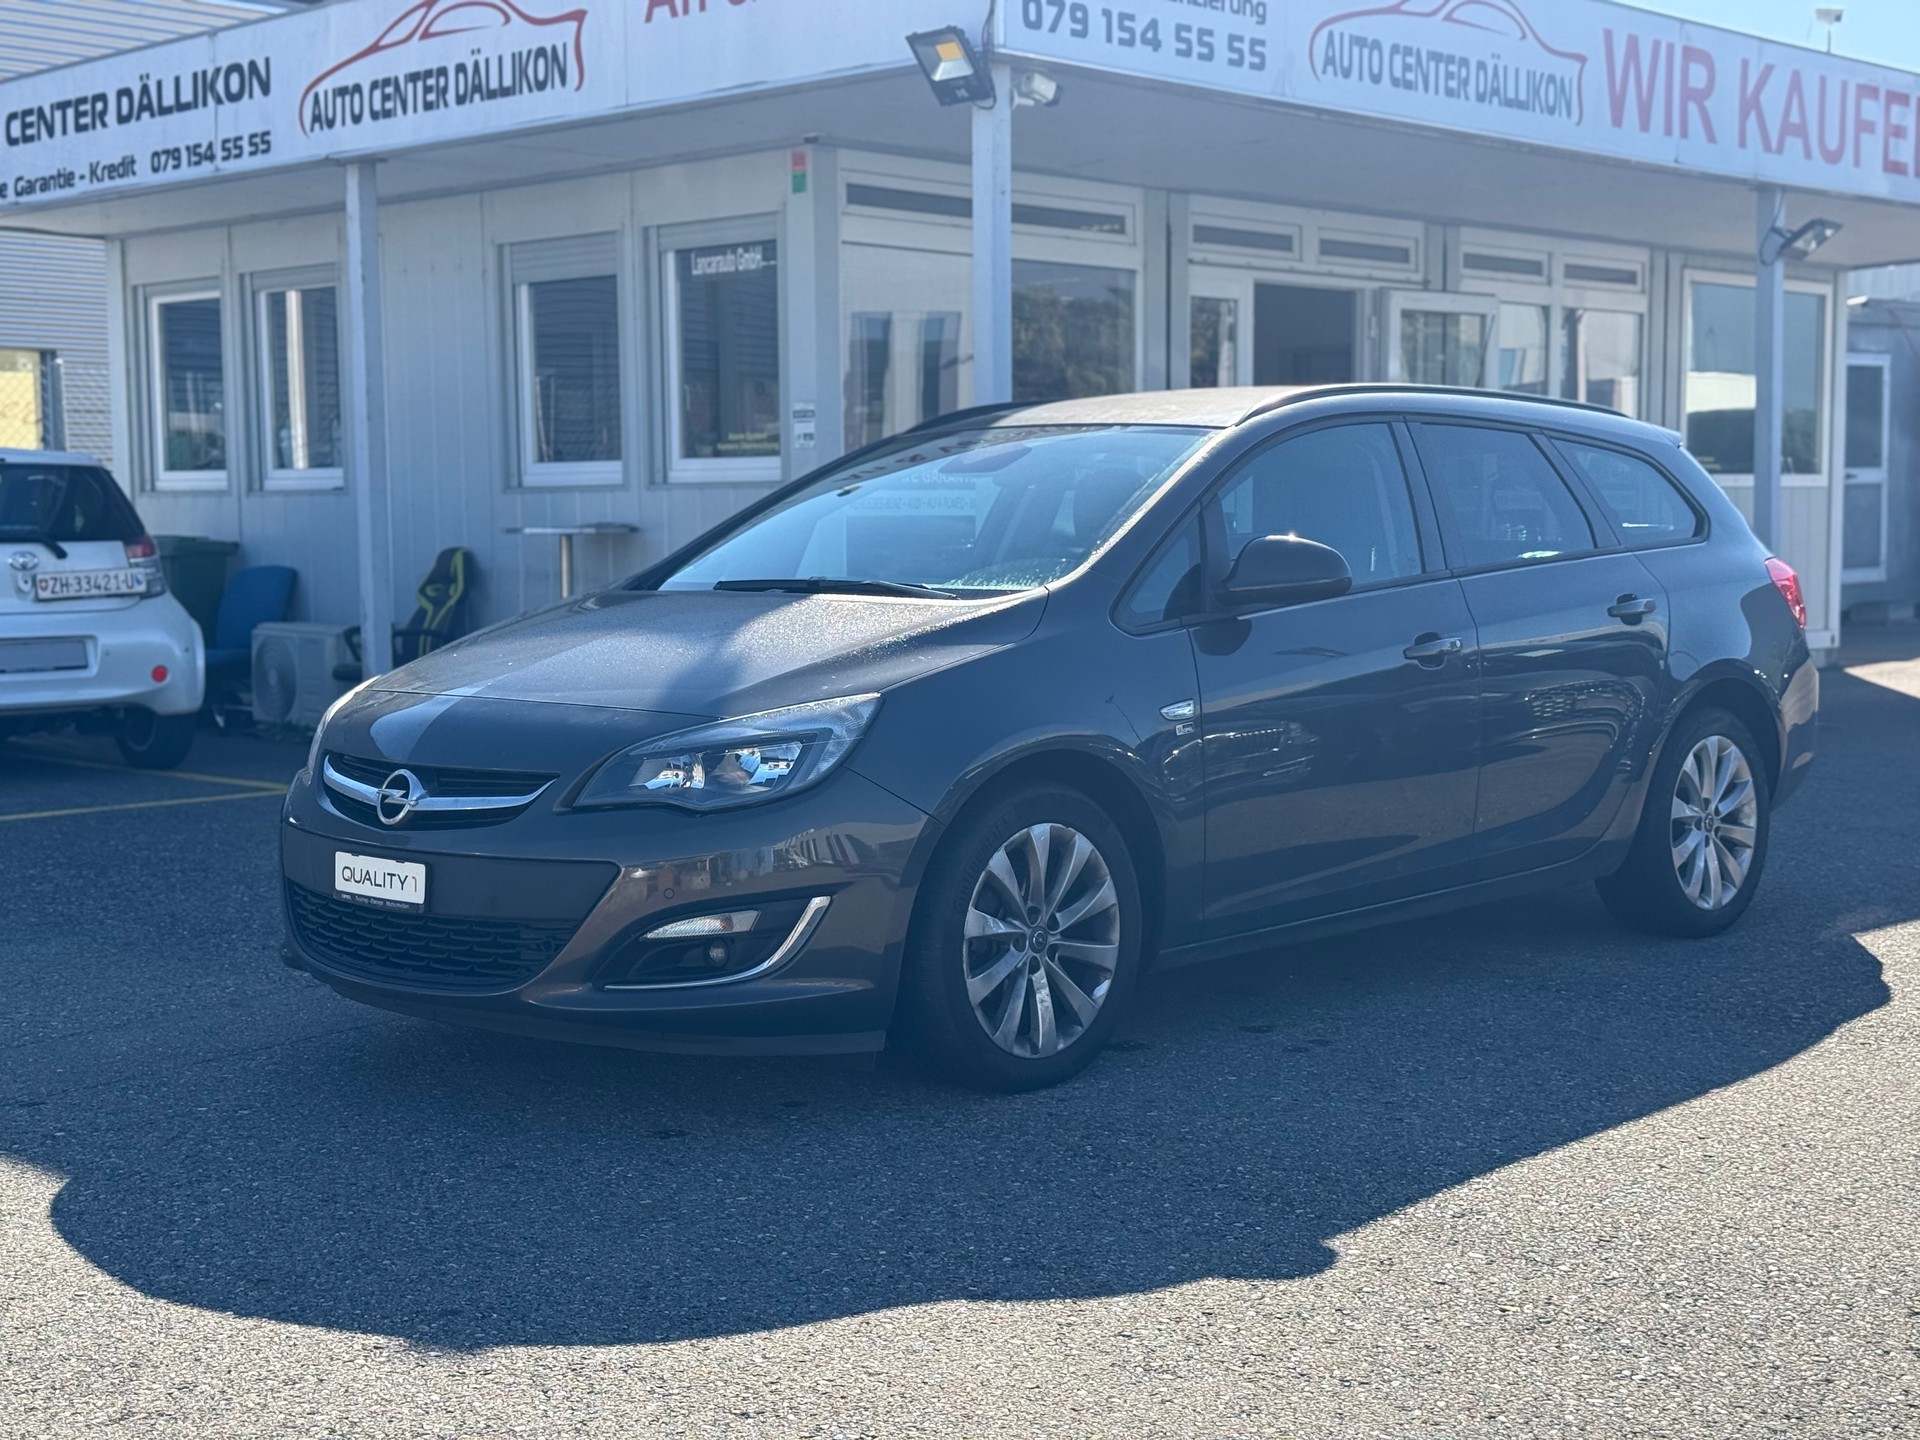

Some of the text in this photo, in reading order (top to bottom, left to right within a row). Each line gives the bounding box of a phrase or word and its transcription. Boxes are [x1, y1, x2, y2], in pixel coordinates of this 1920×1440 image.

[1021, 0, 1266, 71] 079 154 55 55
[1321, 29, 1573, 119] AUTO CENTER DÄLLIKON
[5, 56, 272, 147] CENTER DÄLLIKON
[309, 42, 567, 133] AUTO CENTER DÄLLIKON
[1603, 27, 1718, 145] WIR
[14, 168, 76, 198] Garantie
[89, 154, 137, 184] Kredit
[150, 149, 182, 174] 079
[186, 140, 215, 168] 154
[221, 135, 243, 162] 55
[248, 130, 272, 155] 55
[341, 865, 418, 893] QUALITY 1
